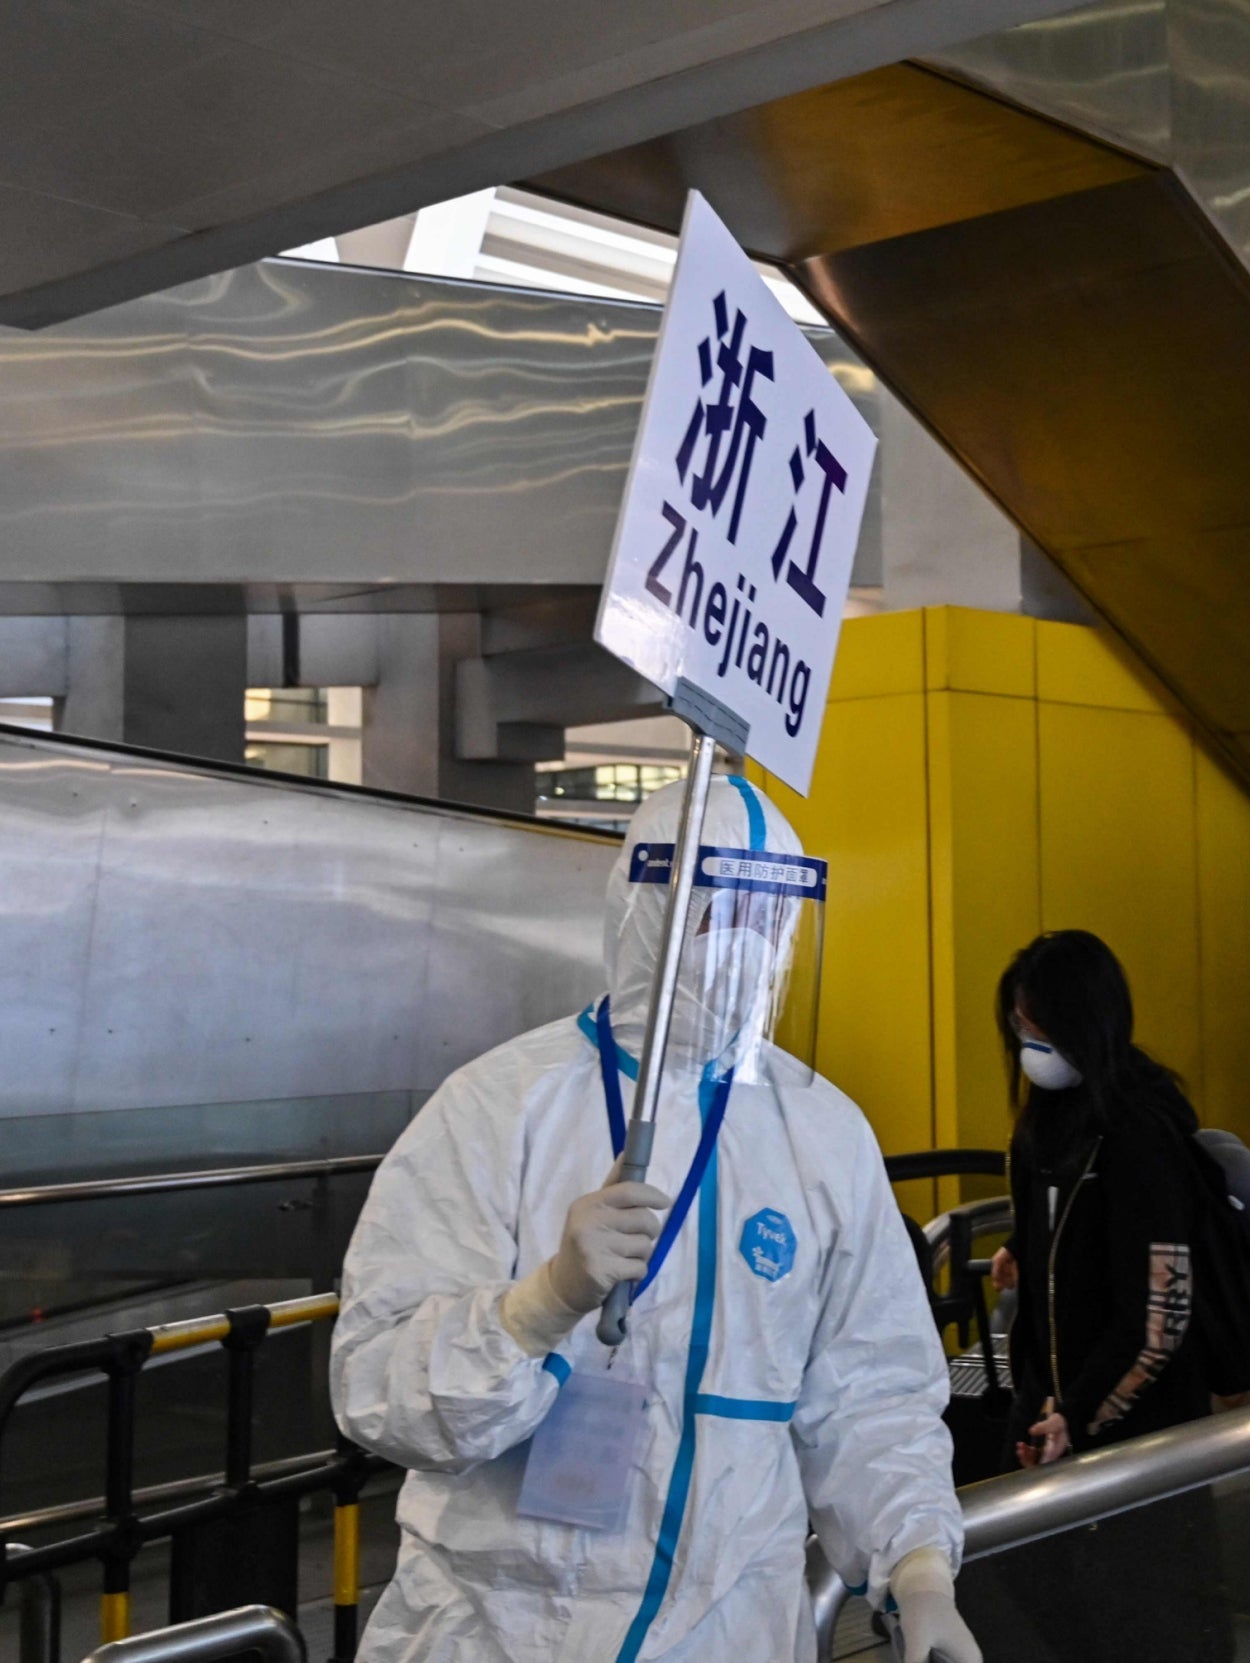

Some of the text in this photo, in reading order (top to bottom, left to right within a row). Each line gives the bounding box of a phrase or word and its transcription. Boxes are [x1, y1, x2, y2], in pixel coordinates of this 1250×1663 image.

[674, 290, 848, 618] 浙江
[644, 500, 811, 738] Zhejiang
[720, 860, 808, 883] 医用防护面罩
